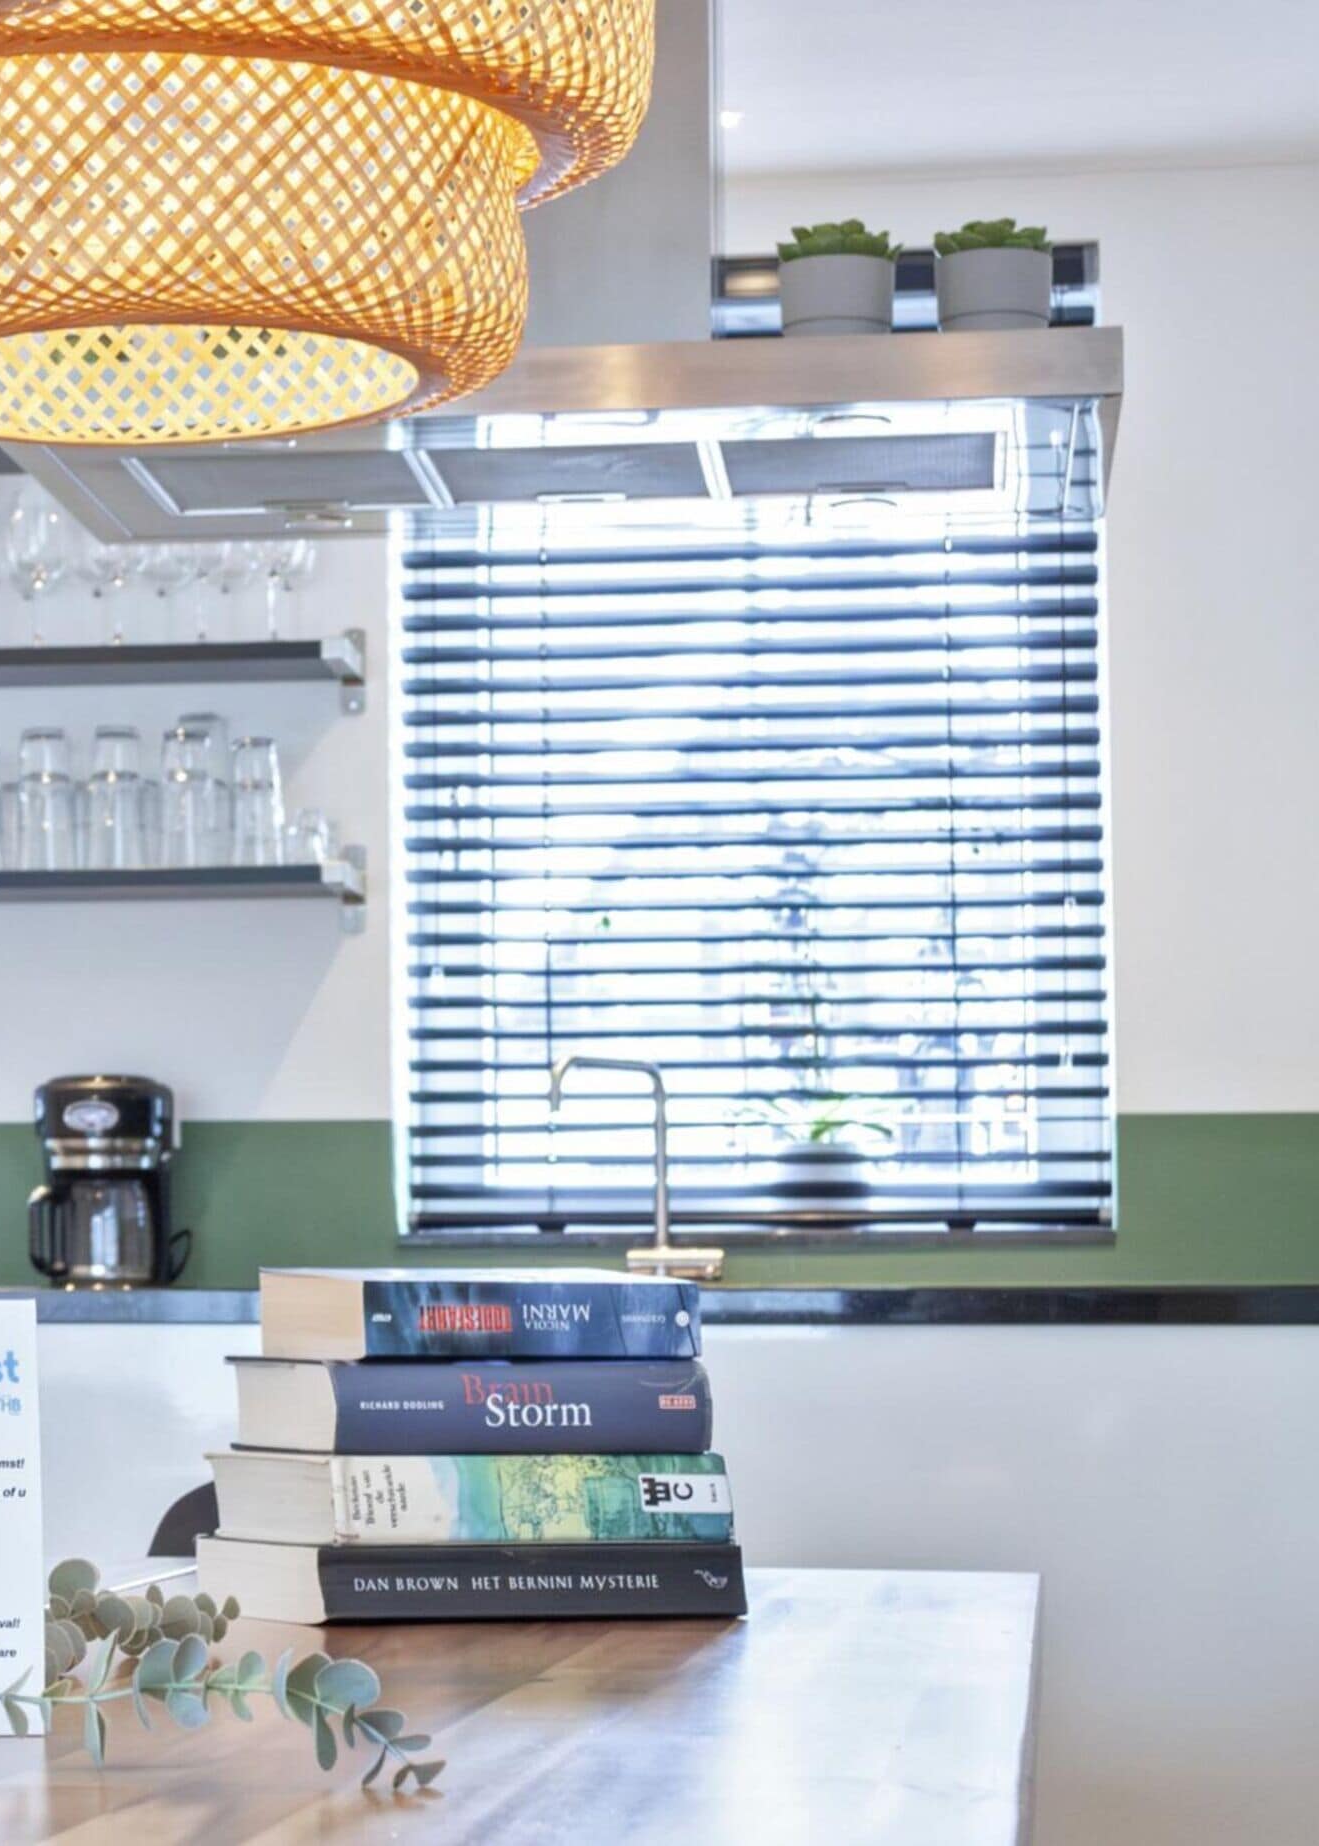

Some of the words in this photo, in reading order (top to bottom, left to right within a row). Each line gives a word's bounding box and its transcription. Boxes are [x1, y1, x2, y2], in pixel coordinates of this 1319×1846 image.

[523, 1303, 590, 1321] MARNI
[524, 1319, 570, 1331] NICOLA
[460, 1374, 554, 1405] Brain
[360, 1400, 400, 1410] RICHARD
[485, 1392, 592, 1427] Storm
[2, 1487, 16, 1497] of
[18, 1488, 26, 1497] u
[673, 1483, 693, 1500] C
[354, 1577, 389, 1592] DAN
[395, 1577, 459, 1592] BROWN
[471, 1575, 500, 1590] HET
[508, 1576, 572, 1590] BERNINI
